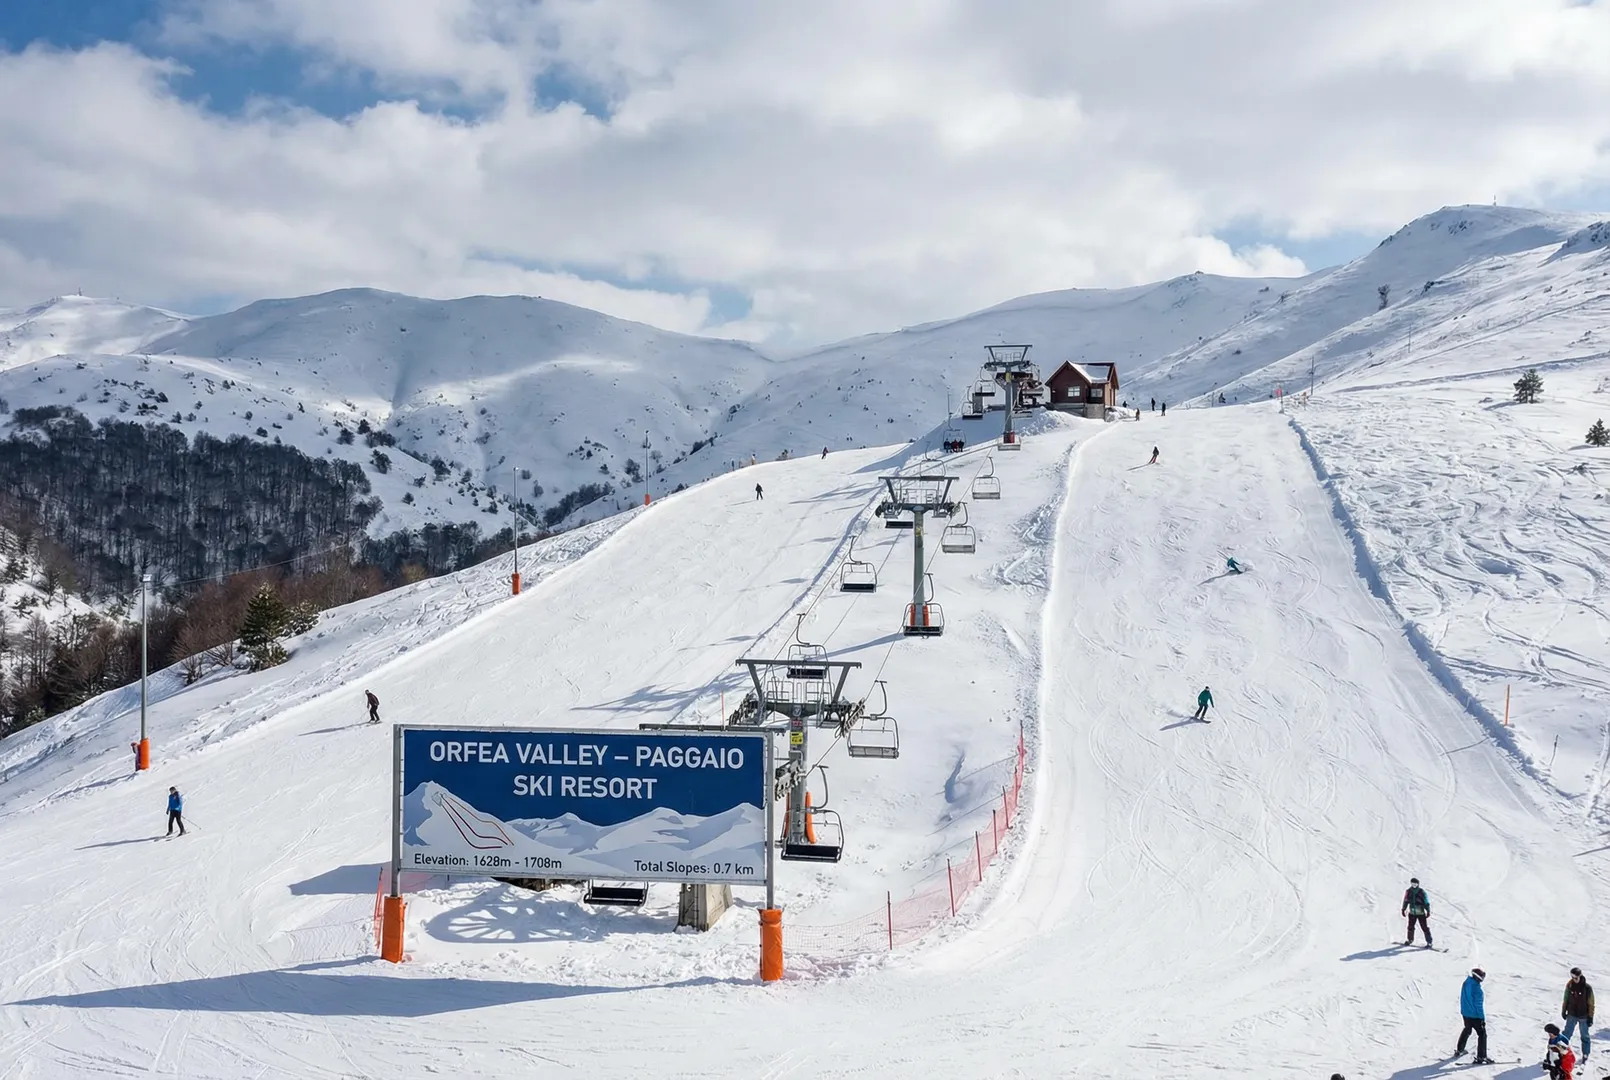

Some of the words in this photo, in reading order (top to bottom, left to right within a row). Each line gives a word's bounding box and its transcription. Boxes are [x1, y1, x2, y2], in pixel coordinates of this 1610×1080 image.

[430, 741, 509, 763] ORFEA
[515, 742, 608, 766] VALLEY
[636, 746, 744, 769] PAGGAIO
[513, 774, 552, 797] SKI
[561, 775, 658, 799] RESORT
[414, 853, 469, 866] Elevation:
[473, 855, 511, 868] 1628m
[524, 856, 562, 869] 1708m
[633, 859, 663, 873] Total
[666, 860, 711, 876] Slopes:
[713, 862, 732, 875] 0.7
[734, 862, 754, 875] km
